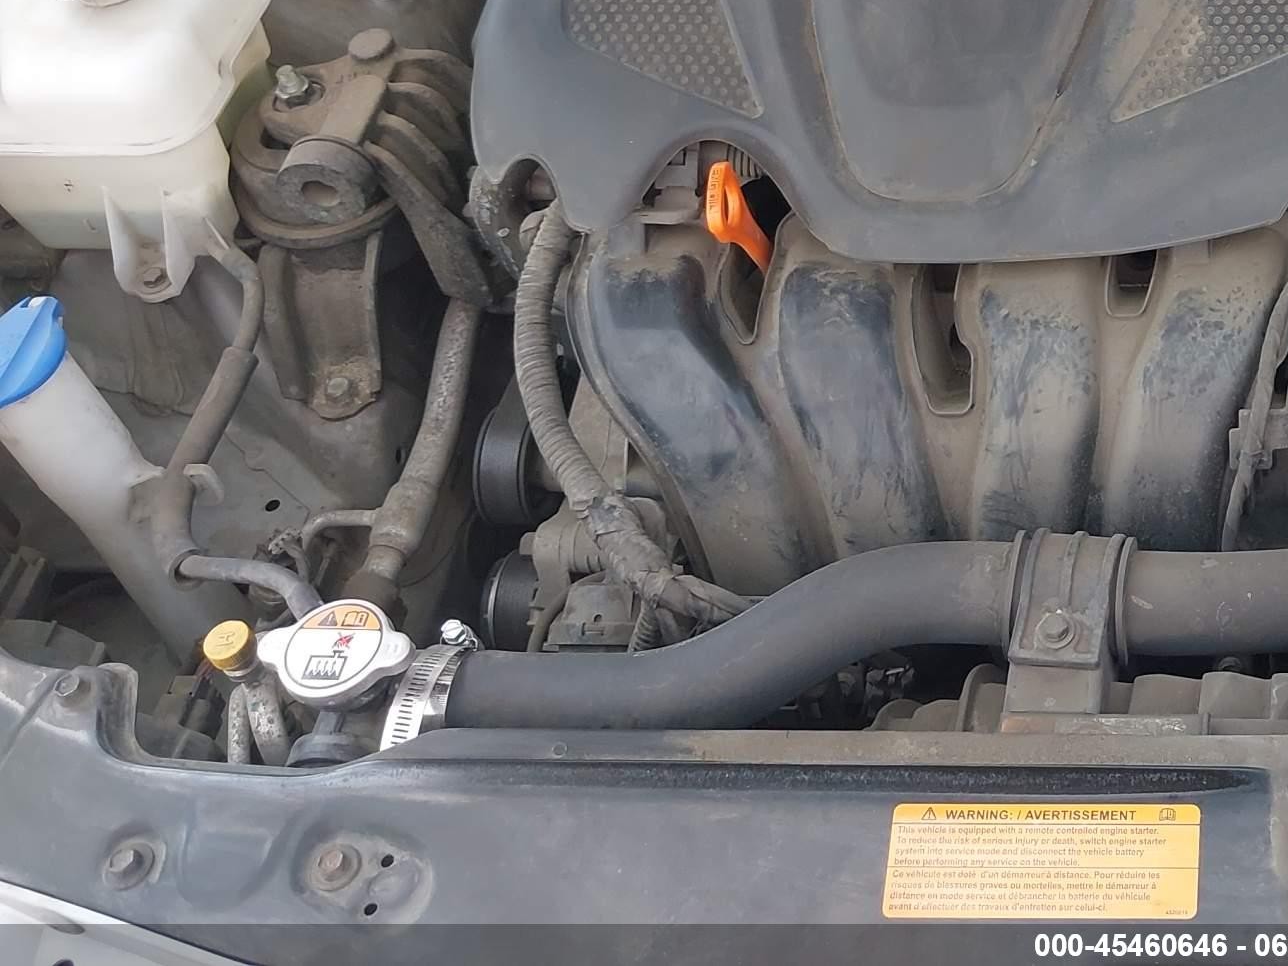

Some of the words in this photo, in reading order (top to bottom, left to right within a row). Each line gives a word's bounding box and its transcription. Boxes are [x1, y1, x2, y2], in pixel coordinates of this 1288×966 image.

[945, 809, 1013, 820] WARNING:
[1025, 810, 1137, 821] AVERTISSEMENT
[898, 826, 915, 835] This
[918, 826, 946, 835] vehicle
[949, 826, 956, 835] is
[958, 826, 996, 838] equipped
[998, 826, 1016, 835] with
[1018, 827, 1023, 835] a
[1025, 826, 1054, 835] remote
[1056, 826, 1098, 835] controlled
[1100, 827, 1128, 838] engine
[1130, 827, 1159, 836] starter.
[897, 836, 907, 844] To
[908, 836, 936, 844] reduce
[938, 836, 952, 844] the
[954, 836, 970, 844] risk
[971, 836, 981, 844] of
[982, 836, 1013, 844] serious
[1015, 837, 1038, 847] injury
[1052, 837, 1078, 846] death,
[1080, 837, 1107, 845] switch
[1109, 838, 1138, 847] engine
[895, 847, 925, 857] system
[927, 847, 943, 855] into
[945, 847, 975, 855] service
[977, 847, 999, 855] mode
[1001, 847, 1018, 855] and
[1020, 847, 1066, 855] disconnect
[1115, 848, 1145, 858] battery
[894, 857, 920, 865] before
[922, 857, 968, 868] performing
[970, 859, 985, 868] any
[987, 858, 1018, 866] service
[1033, 858, 1046, 866] the
[1048, 858, 1080, 866] vehicle.
[892, 870, 904, 878] Ce
[906, 870, 941, 878] véhicule
[942, 870, 957, 878] est
[958, 870, 976, 878] doté
[980, 870, 999, 878] d'un
[1001, 870, 1045, 879] démarreur
[1046, 870, 1051, 879] à
[1054, 871, 1091, 879] distance.
[1094, 871, 1114, 879] Pour
[1116, 871, 1146, 879] réduire
[1148, 871, 1161, 879] les
[891, 881, 922, 892] risques
[924, 881, 935, 889] de
[936, 881, 978, 889] blessures
[979, 881, 1008, 892] graves
[1023, 881, 1065, 891] mortelles,
[1066, 882, 1093, 890] mettre
[1096, 882, 1103, 890] le
[1105, 882, 1149, 890] démarreur
[1151, 882, 1157, 890] à
[889, 892, 925, 900] distance
[939, 892, 964, 900] mode
[965, 892, 996, 900] service
[998, 892, 1006, 900] et
[1008, 892, 1056, 900] débrancher
[1058, 893, 1066, 901] la
[1068, 893, 1100, 901] batterie
[1102, 893, 1113, 901] du
[1115, 893, 1151, 901] véhicule
[888, 902, 912, 911] avant
[913, 902, 959, 911] d'effectuer
[960, 902, 976, 911] des
[978, 902, 1009, 911] travaux
[1011, 902, 1057, 911] d'entretien
[1058, 903, 1073, 911] sur
[1074, 903, 1107, 912] celui-ci.
